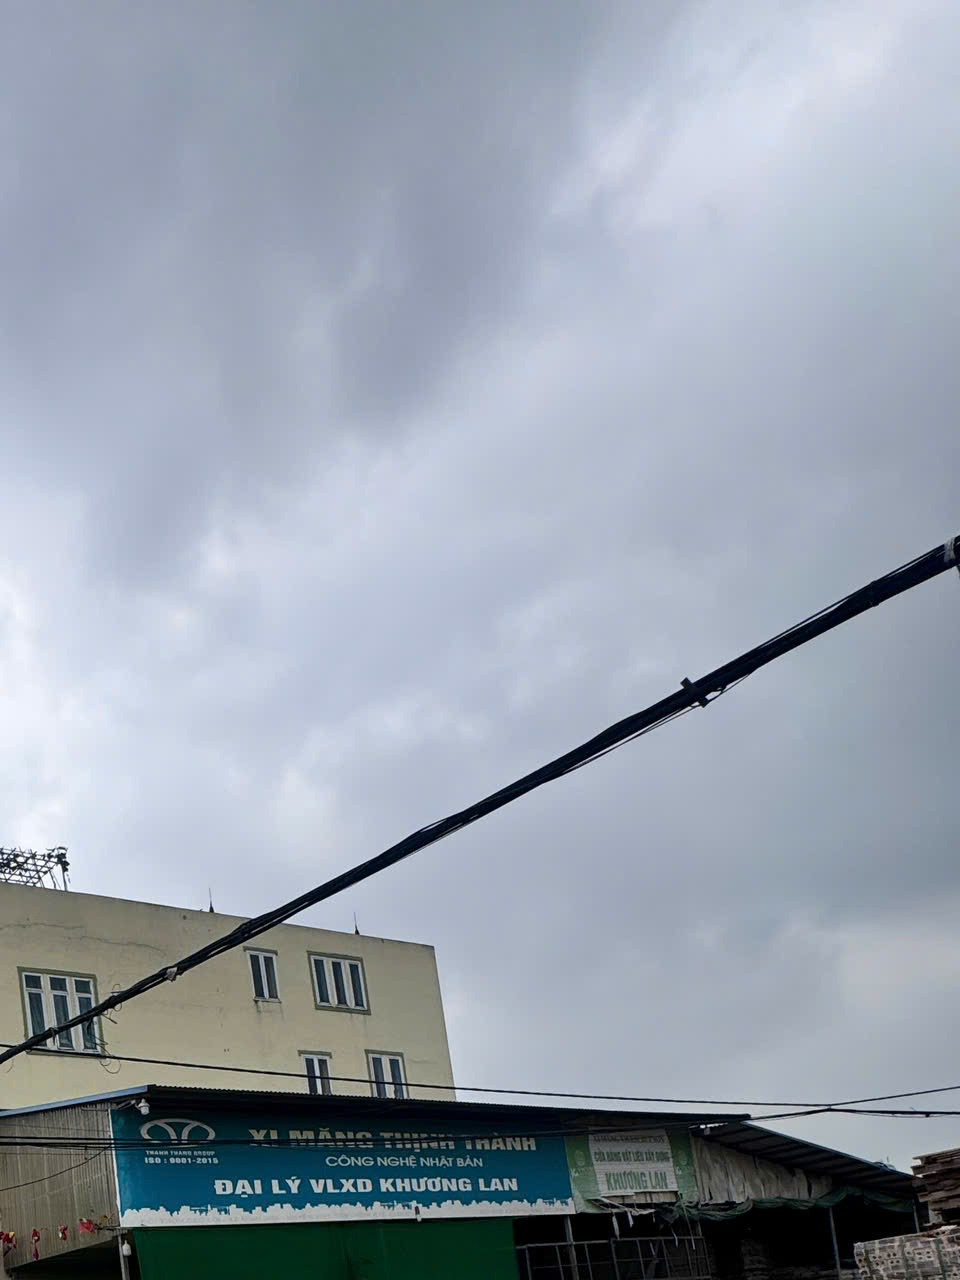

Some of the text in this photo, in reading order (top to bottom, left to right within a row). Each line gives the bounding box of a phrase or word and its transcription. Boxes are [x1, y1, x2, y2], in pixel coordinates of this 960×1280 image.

[325, 1154, 484, 1168] CÔNG NGHỆ NHẬT BẢN
[213, 1176, 519, 1198] ĐẠI LÝ VLXD KHƯƠNG LAN
[648, 1171, 668, 1190] LAN
